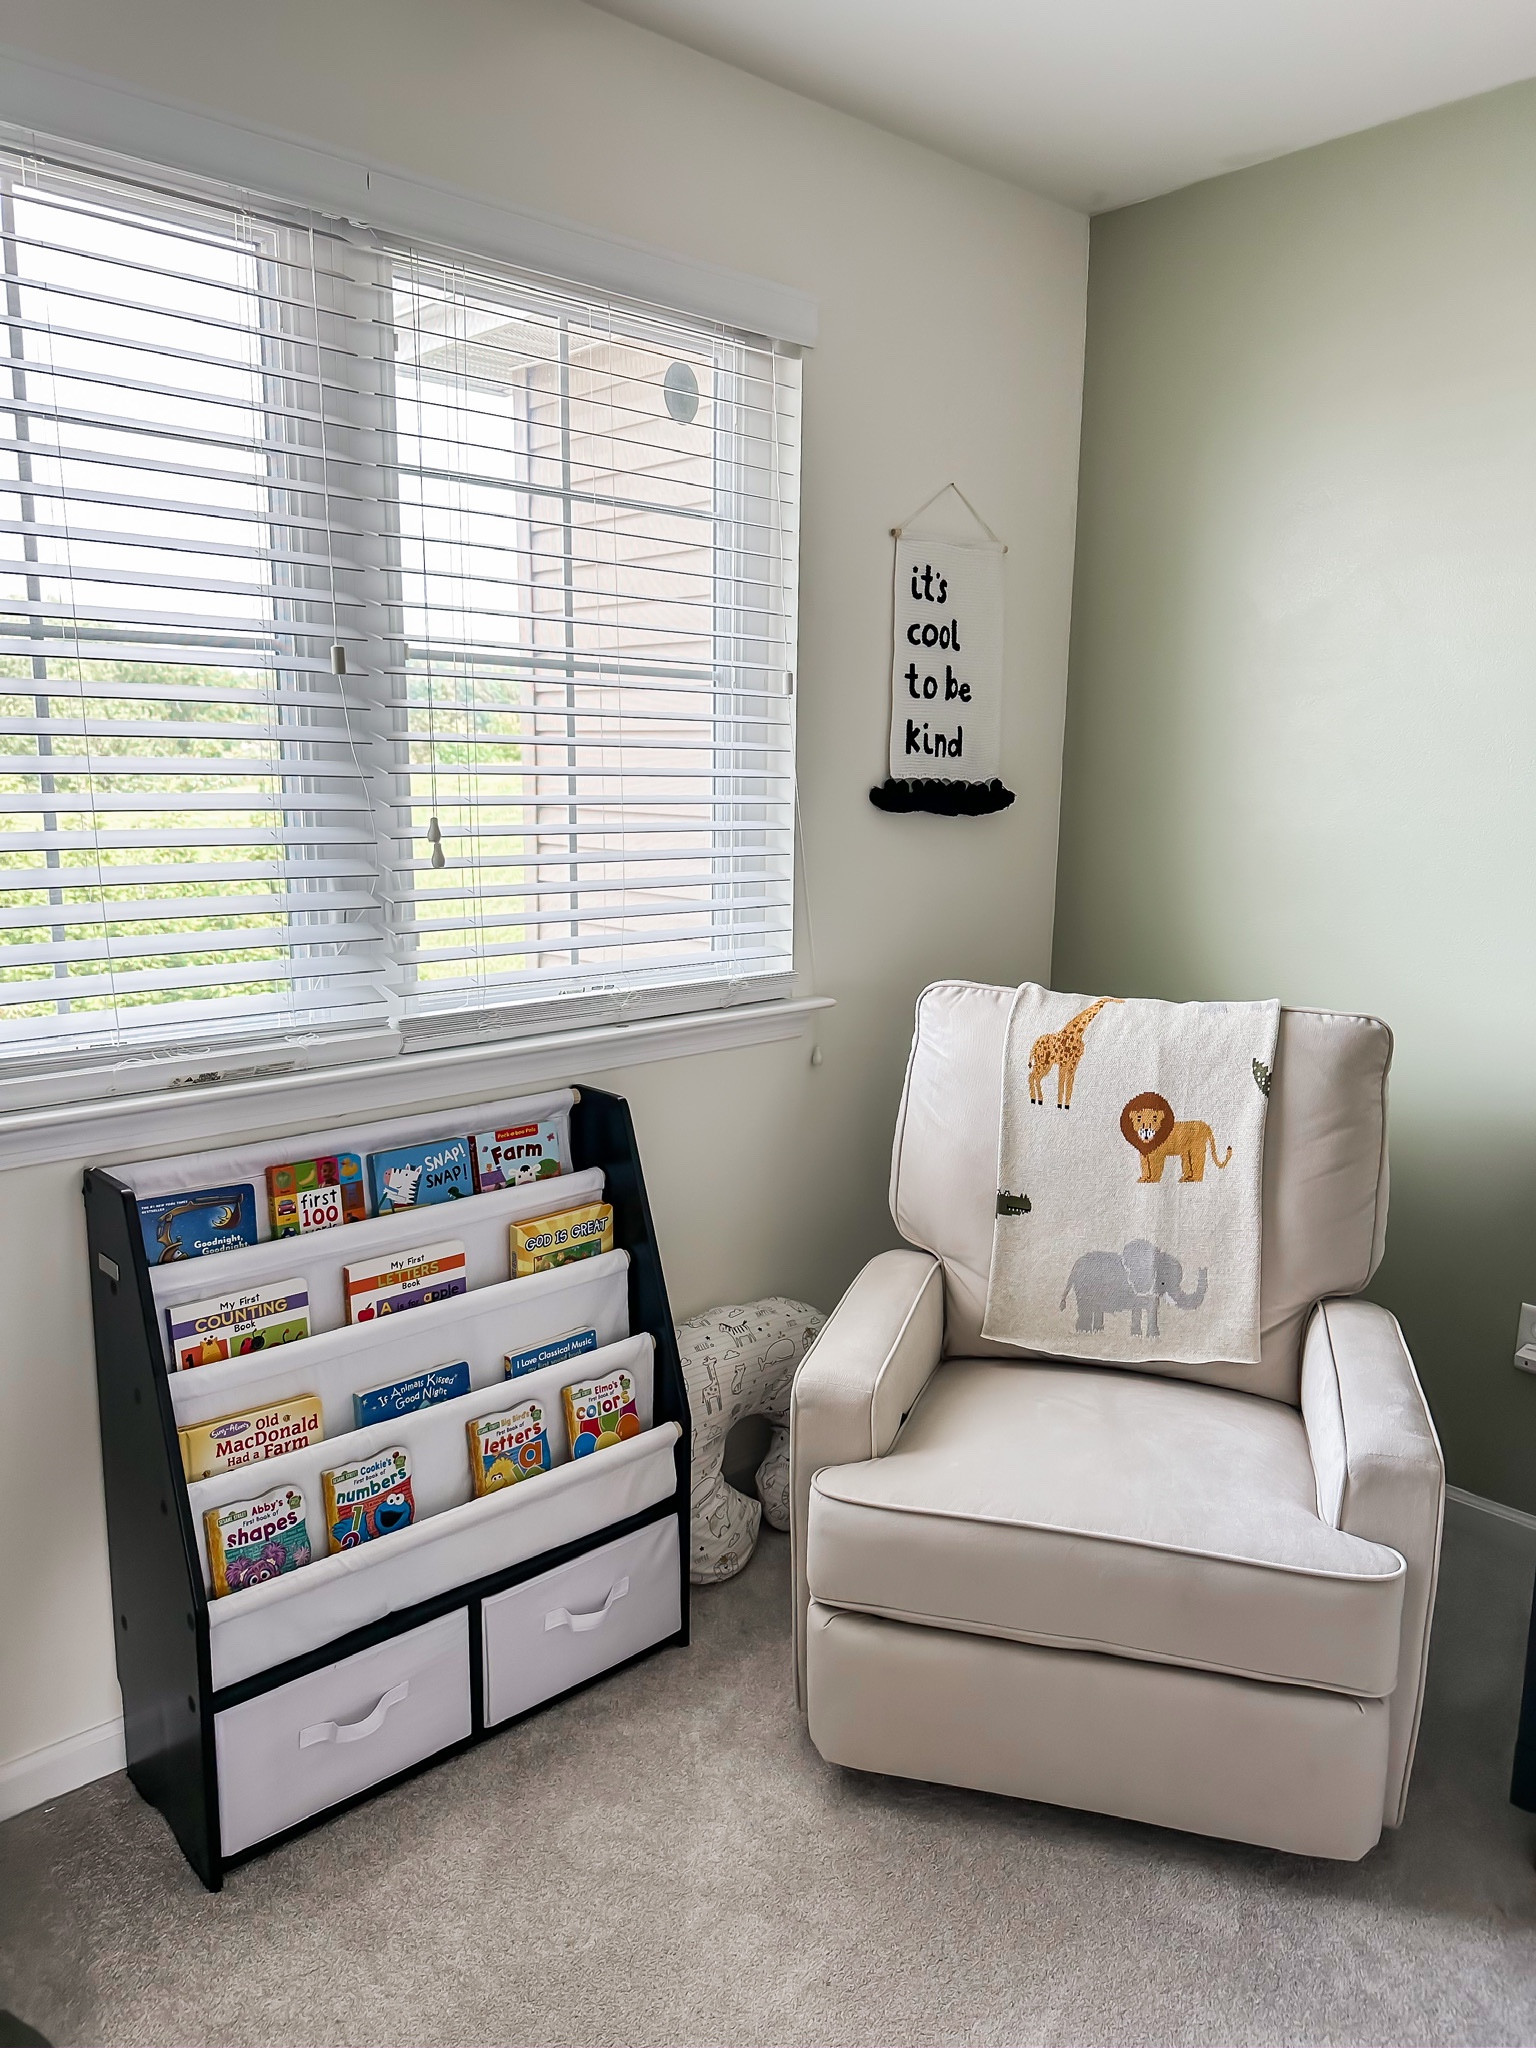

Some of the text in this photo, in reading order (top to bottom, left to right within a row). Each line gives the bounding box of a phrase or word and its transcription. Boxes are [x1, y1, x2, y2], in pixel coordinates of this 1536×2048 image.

[911, 564, 948, 604] it's
[907, 619, 960, 651] cool
[904, 663, 972, 702] to be
[905, 719, 963, 758] kind
[424, 1143, 466, 1172] SNAP!
[490, 1143, 542, 1166] Farm
[425, 1163, 468, 1189] SNAP!
[300, 1189, 337, 1209] first
[303, 1205, 339, 1227] 100
[194, 1234, 244, 1249] Goodnight,
[525, 1217, 608, 1251] GOD IS GREAT
[377, 1261, 439, 1288] LETTERS
[391, 1254, 425, 1270] My First
[402, 1279, 421, 1290] Book
[220, 1293, 261, 1311] My First
[380, 1302, 392, 1315] A
[423, 1284, 460, 1303] apple
[195, 1299, 288, 1333] COUNTING
[234, 1320, 256, 1333] Book
[185, 1354, 195, 1368] 1
[516, 1338, 593, 1369] I Love Classical Music
[390, 1379, 424, 1400] Animals
[426, 1373, 454, 1387] Kissed
[395, 1387, 448, 1410] Good Night
[594, 1380, 618, 1395] Elmo's
[576, 1390, 630, 1420] colors
[255, 1413, 279, 1430] Old
[500, 1417, 511, 1427] Big
[506, 1425, 518, 1433] Book
[216, 1413, 319, 1458] MacDonald
[484, 1422, 542, 1455] letters
[227, 1435, 310, 1467] Had a Farm
[518, 1439, 543, 1469] a
[353, 1468, 386, 1486] First Book of
[360, 1457, 392, 1476] Cookie's
[336, 1467, 407, 1505] numbers
[242, 1509, 279, 1528] First Book of
[251, 1499, 284, 1516] Abby's
[352, 1505, 363, 1531] 1
[227, 1511, 298, 1548] shapes
